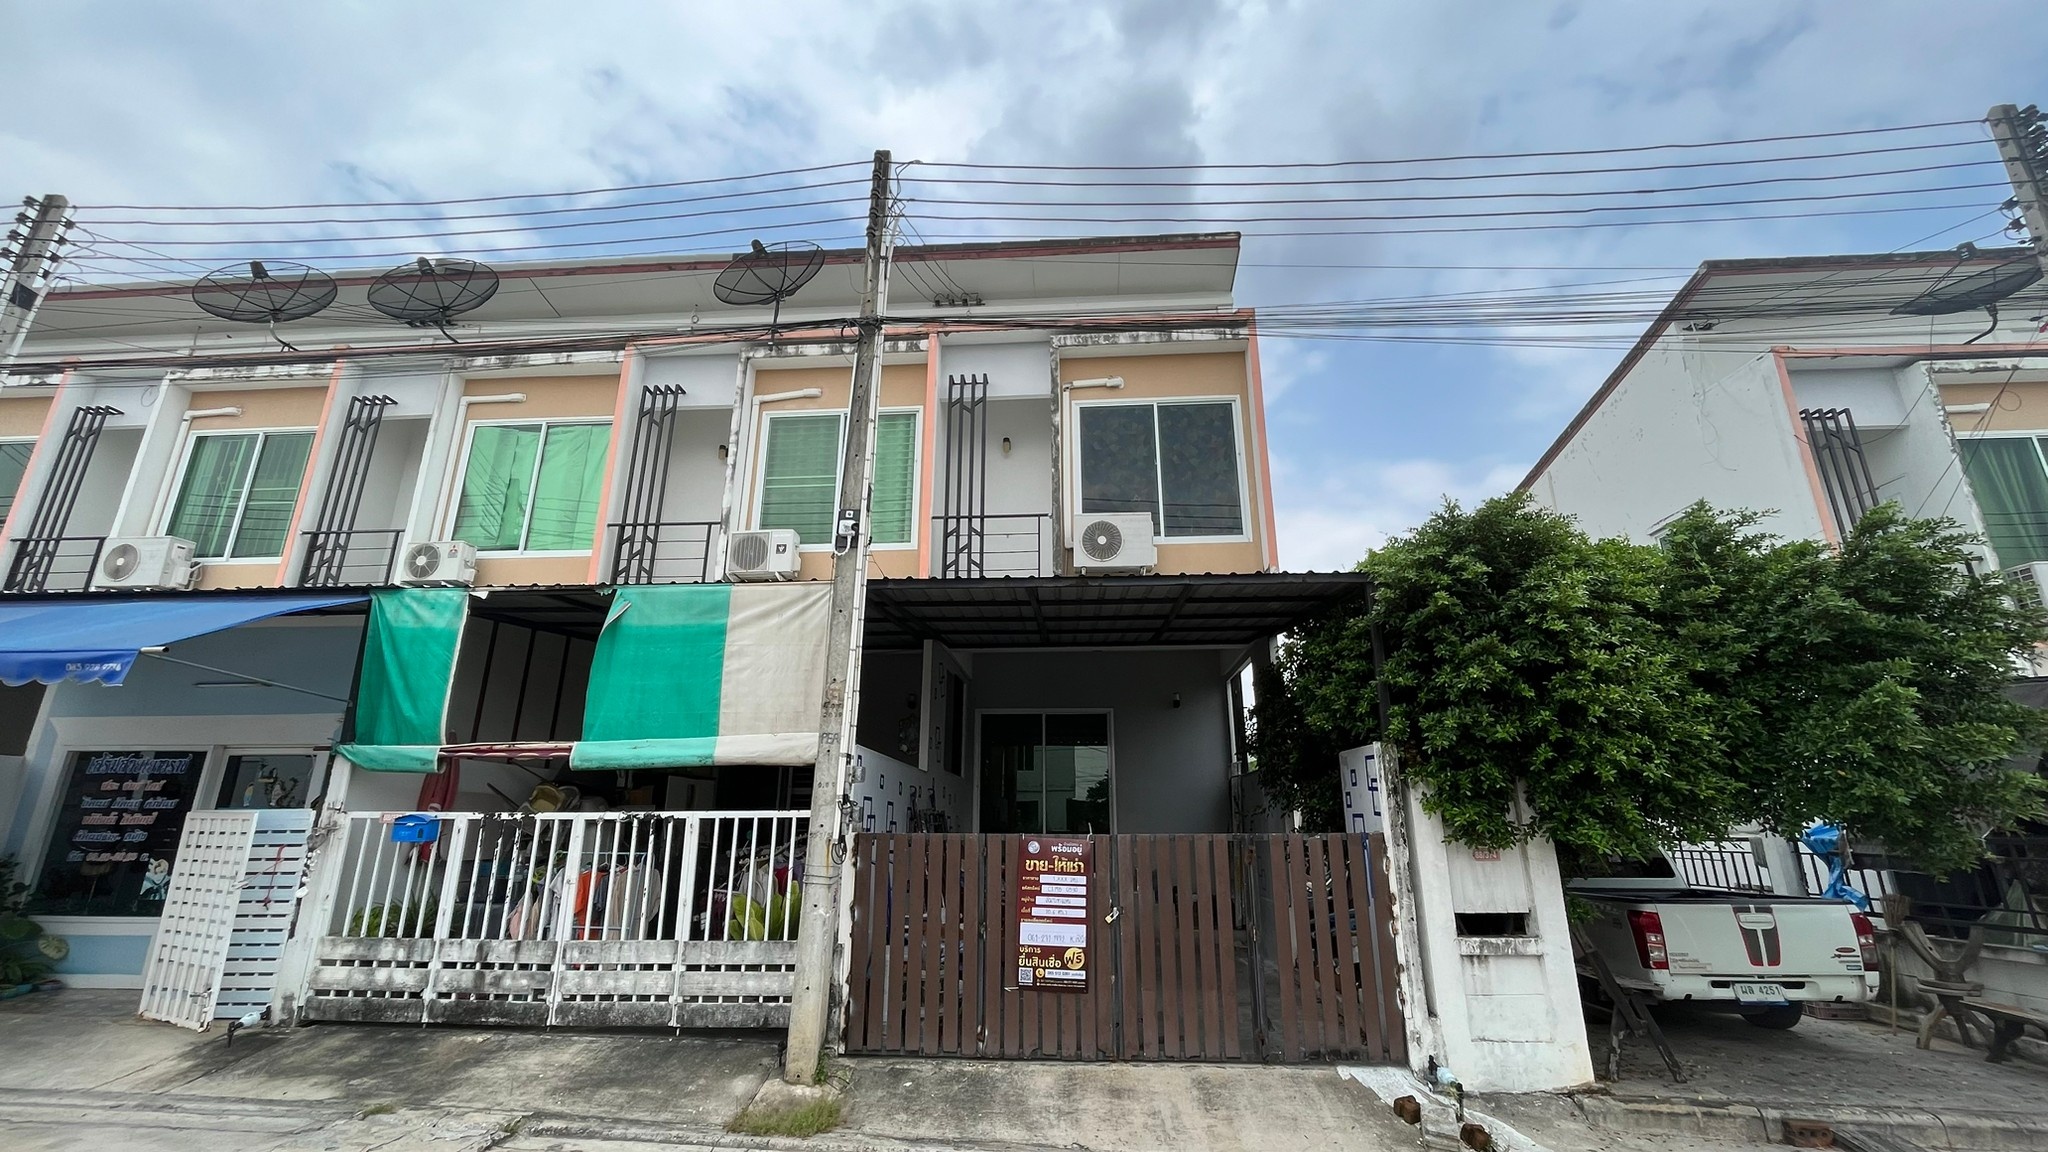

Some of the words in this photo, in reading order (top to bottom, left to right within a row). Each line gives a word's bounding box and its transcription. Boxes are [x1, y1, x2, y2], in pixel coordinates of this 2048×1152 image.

[1051, 843, 1083, 856] พร้อมอยู่
[1025, 855, 1085, 873] ขาย-ให้เช่า
[1019, 945, 1041, 953] บริการ
[1019, 952, 1062, 968] ยื่นสินเชื่อ
[1065, 949, 1083, 965] ฟรี
[1759, 985, 1781, 995] 4251
